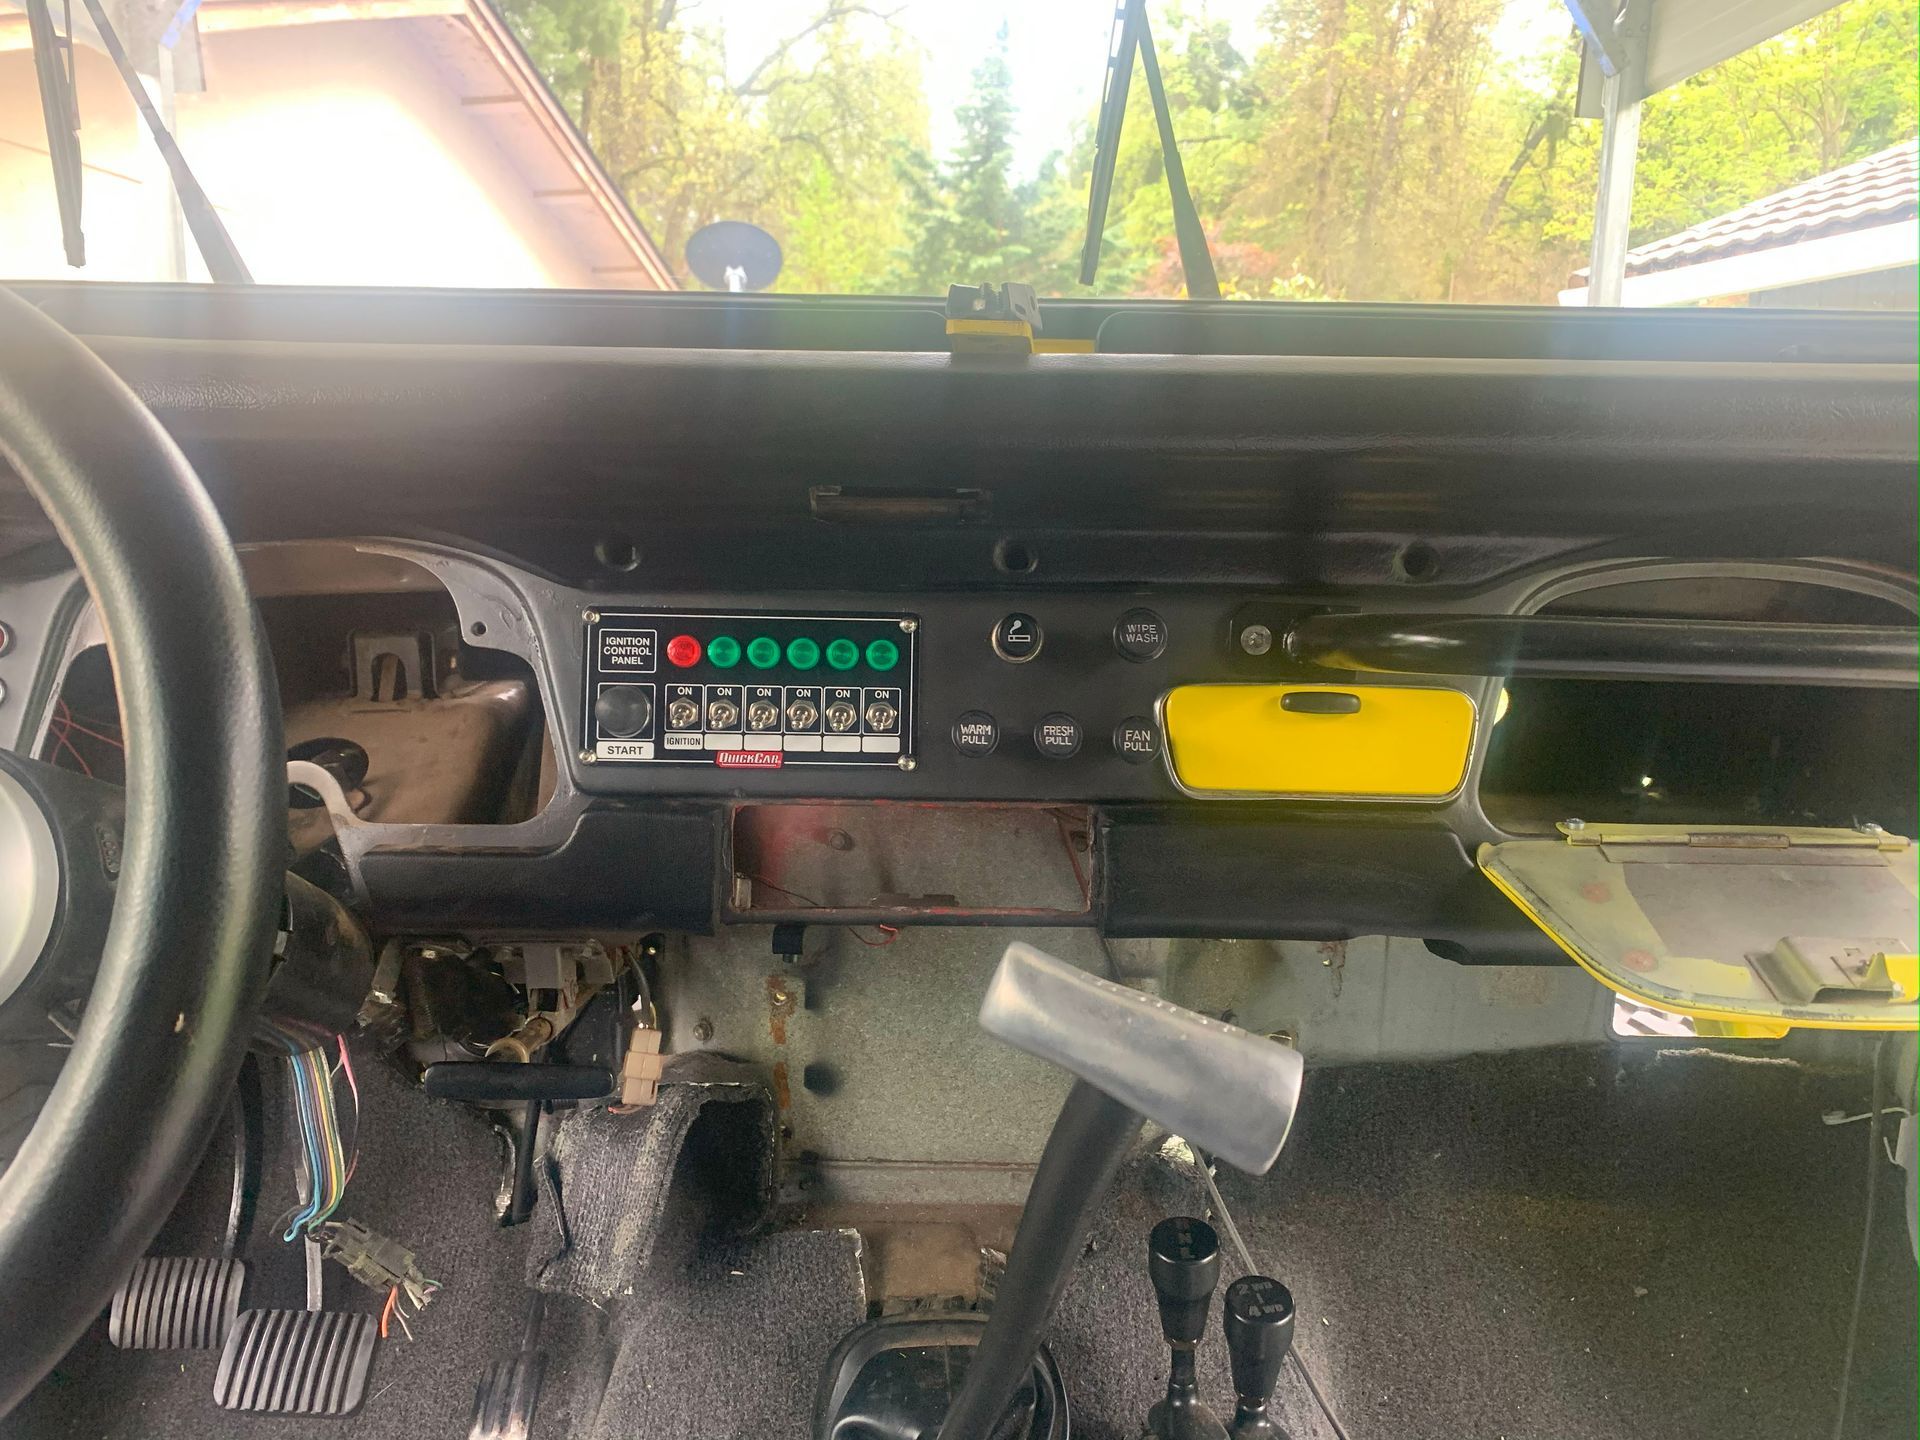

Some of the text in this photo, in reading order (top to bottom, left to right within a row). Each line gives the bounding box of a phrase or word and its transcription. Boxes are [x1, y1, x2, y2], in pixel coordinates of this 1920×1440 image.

[1127, 624, 1157, 634] WIPE
[605, 637, 650, 646] IGNITION
[1126, 633, 1159, 643] WASH
[603, 646, 652, 656] CONTROL
[611, 656, 644, 665] PANEL
[677, 687, 692, 696] ON
[717, 687, 732, 696] ON
[757, 688, 772, 697] ON
[796, 689, 811, 697] ON
[835, 690, 850, 698] ON
[875, 690, 889, 698] ON
[960, 724, 991, 736] WARM
[1043, 725, 1074, 737] FRESH
[961, 735, 989, 745] PULL
[1125, 730, 1150, 741] FAN
[666, 737, 701, 746] IGNITION
[1045, 736, 1072, 745] PULL
[607, 746, 644, 755] START
[1123, 741, 1153, 751] PULL
